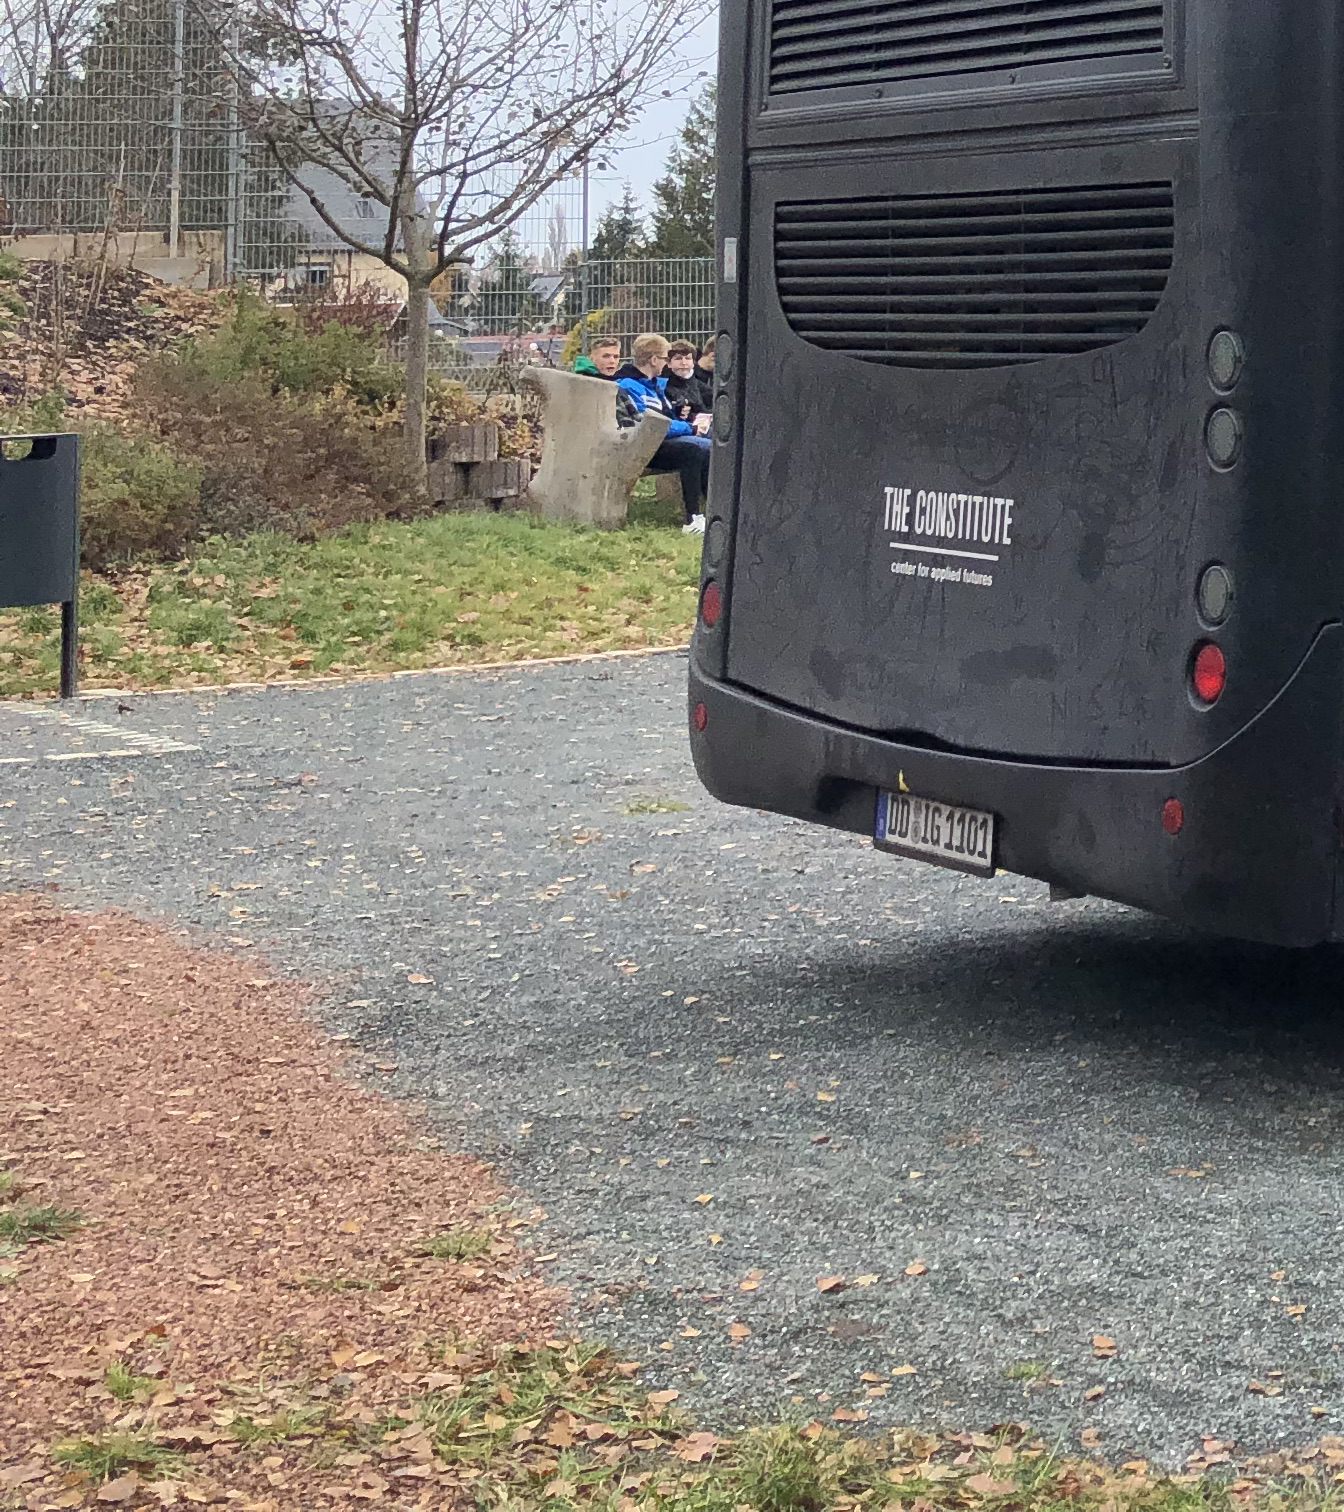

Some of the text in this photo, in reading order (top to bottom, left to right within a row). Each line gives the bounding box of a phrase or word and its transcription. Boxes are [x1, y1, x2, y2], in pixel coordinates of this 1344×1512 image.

[884, 487, 1014, 545] THE CONSTITUTE
[890, 561, 993, 587] center for applied futures
[888, 794, 911, 838] DD
